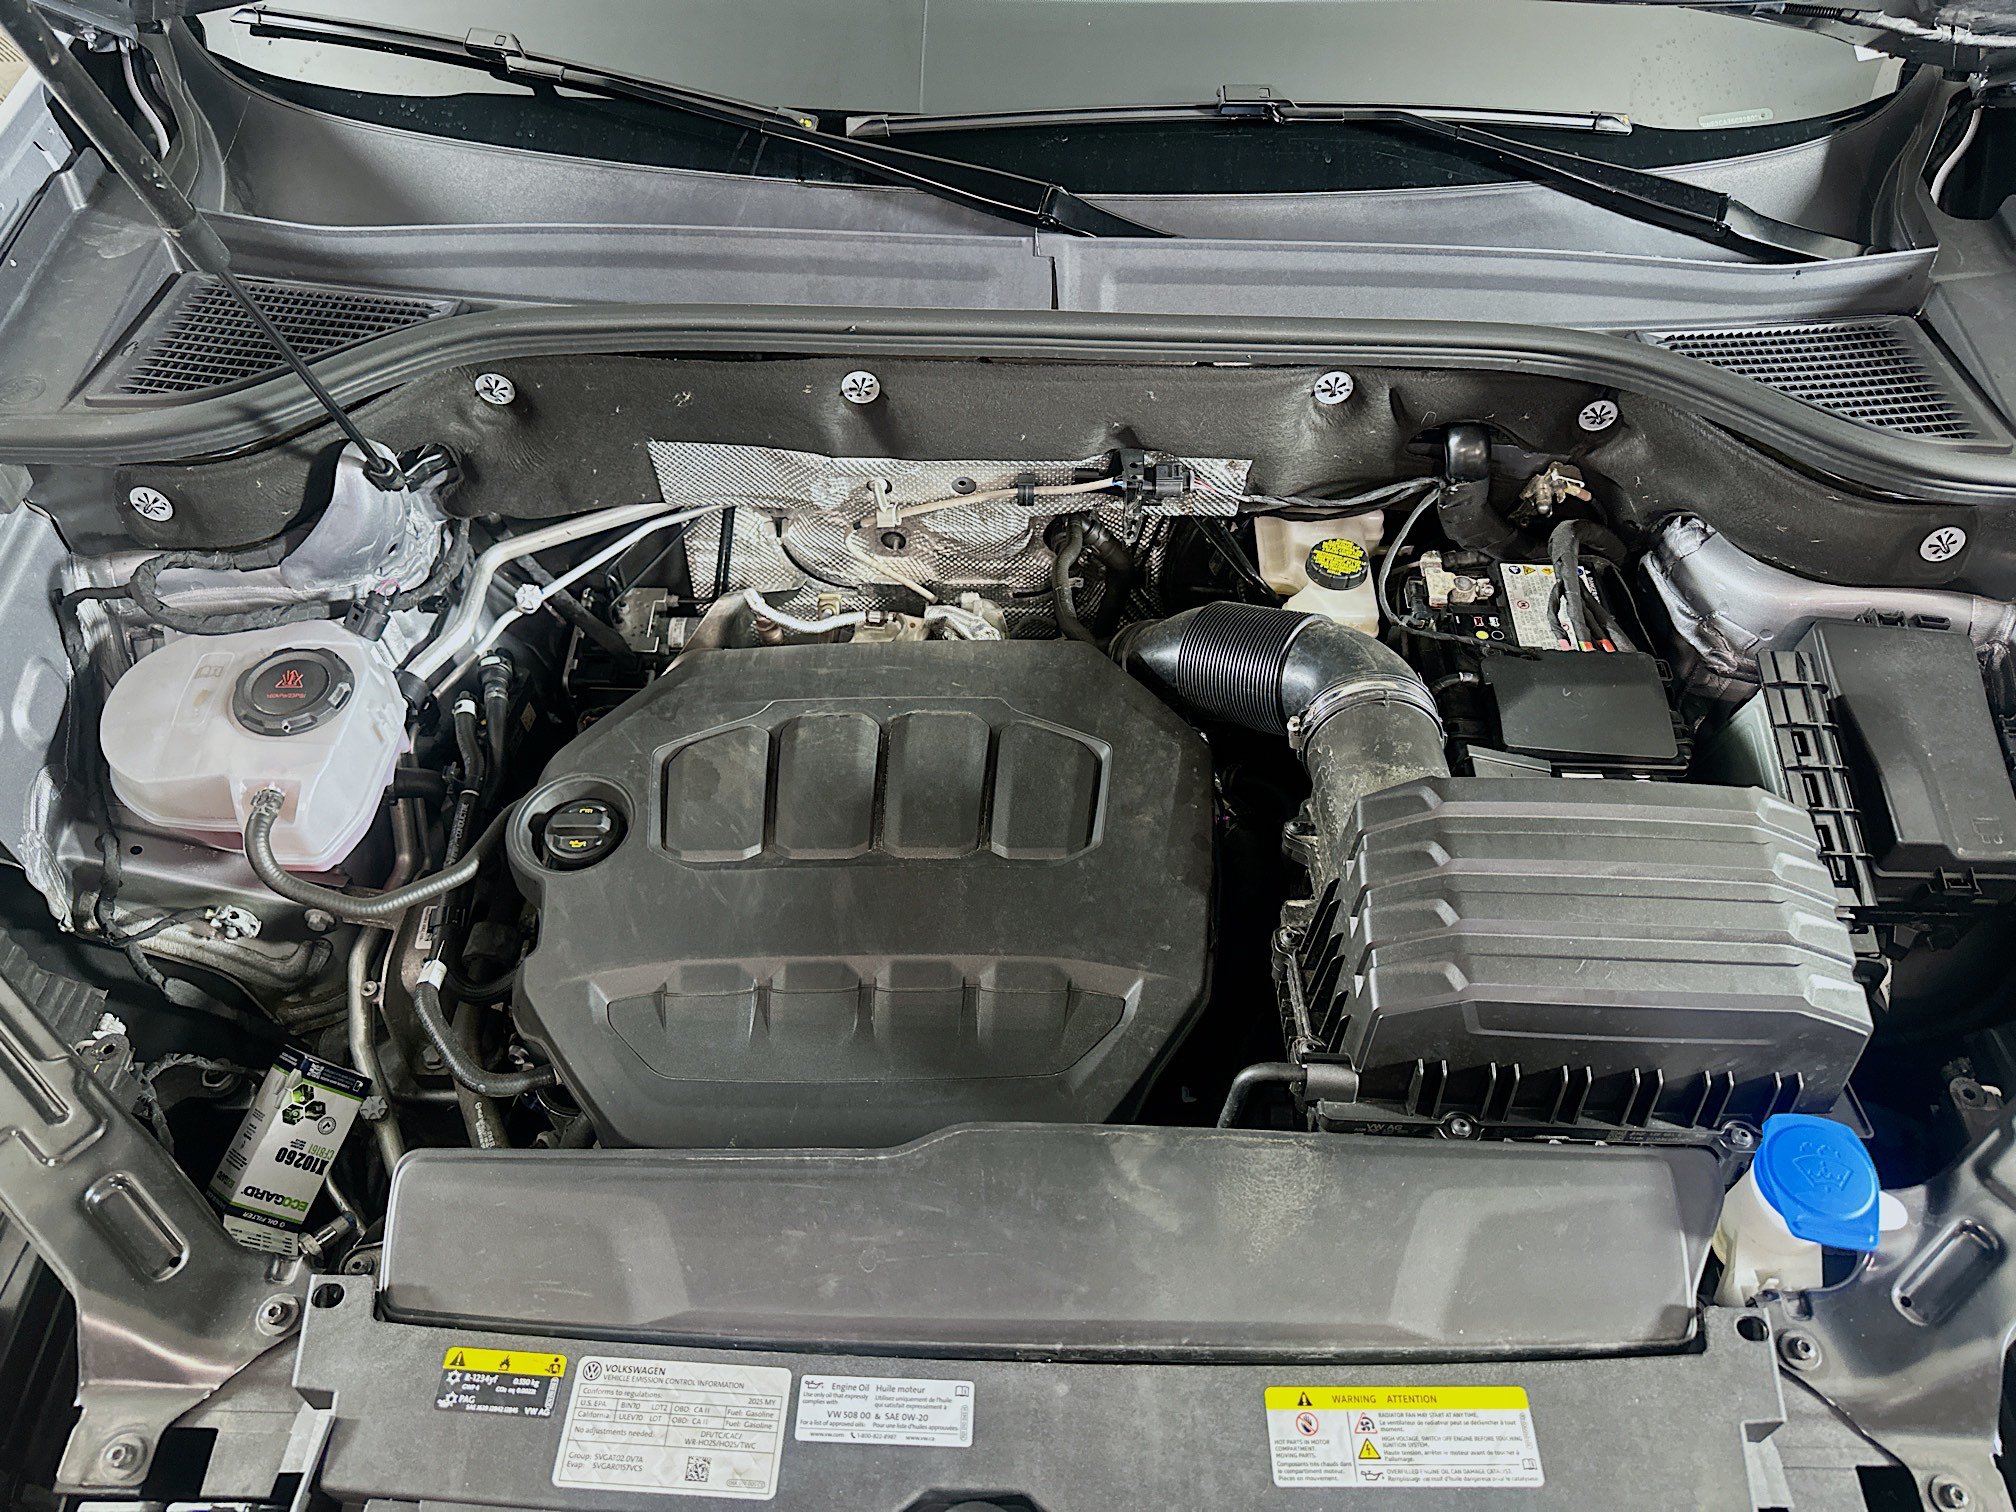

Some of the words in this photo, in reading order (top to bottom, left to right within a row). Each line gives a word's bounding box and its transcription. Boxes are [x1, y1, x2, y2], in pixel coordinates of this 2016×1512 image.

[308, 1143, 335, 1160] CF8161
[274, 1147, 330, 1176] X10260
[244, 1185, 309, 1212] ECOGARD
[242, 1211, 266, 1223] FILTER
[606, 1364, 666, 1375] VOLKSWAGEN
[464, 1372, 499, 1386] R-1234yf
[604, 1374, 629, 1382] VEHICLE
[665, 1378, 696, 1386] CONTROL
[698, 1379, 744, 1389] INFORMATION
[832, 1383, 857, 1392] Engine
[583, 1387, 614, 1396] Conforms
[624, 1389, 663, 1399] regulations:
[458, 1395, 476, 1404] PAG
[1332, 1395, 1376, 1403] WARNING
[1387, 1395, 1437, 1403] ATTENTION
[524, 1406, 538, 1416] VW
[538, 1408, 551, 1416] AG
[746, 1410, 774, 1418] Gasoline
[585, 1427, 627, 1436] adjustments
[569, 1452, 591, 1460] Group:
